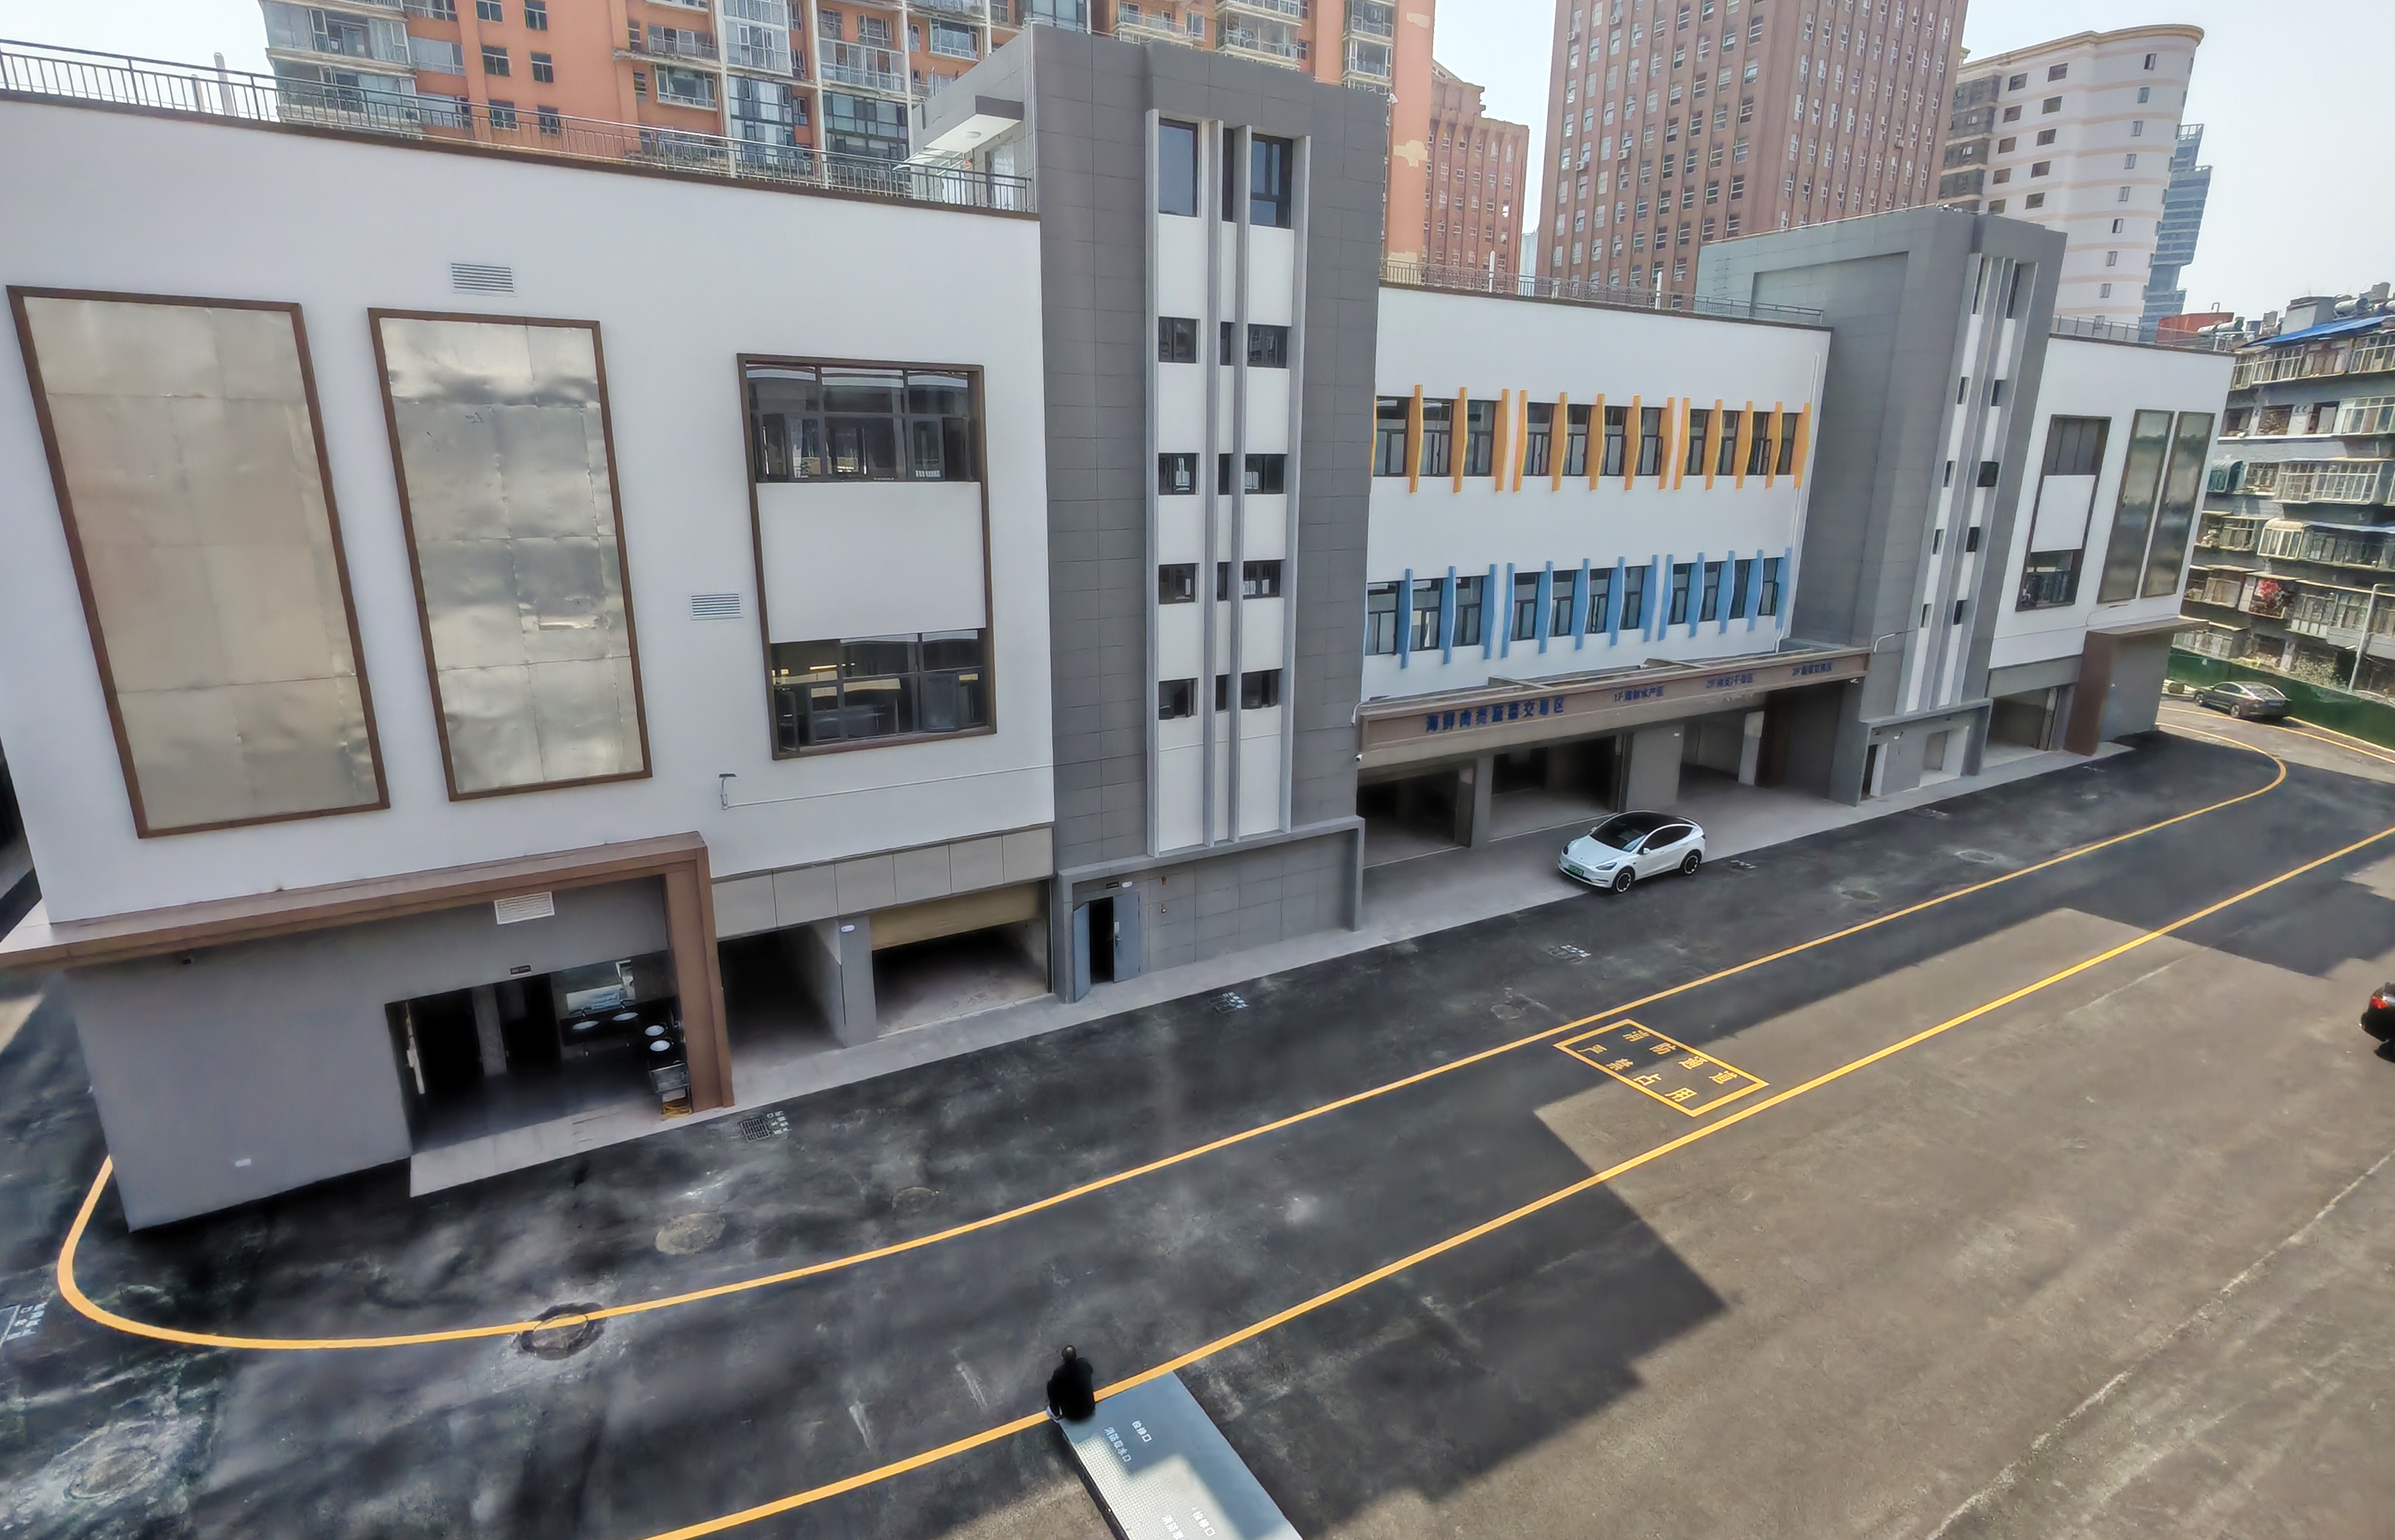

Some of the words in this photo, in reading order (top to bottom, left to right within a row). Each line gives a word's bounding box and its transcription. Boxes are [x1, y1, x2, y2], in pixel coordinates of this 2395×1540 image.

[1622, 1030, 1738, 1085] 消防通道
[1577, 1044, 1697, 1102] 严禁占用
[1103, 1427, 1132, 1462] 消防取水口
[1132, 1420, 1152, 1442] 检修口
[1162, 1515, 1185, 1540] 消防取
[1192, 1511, 1216, 1537] 检修口
